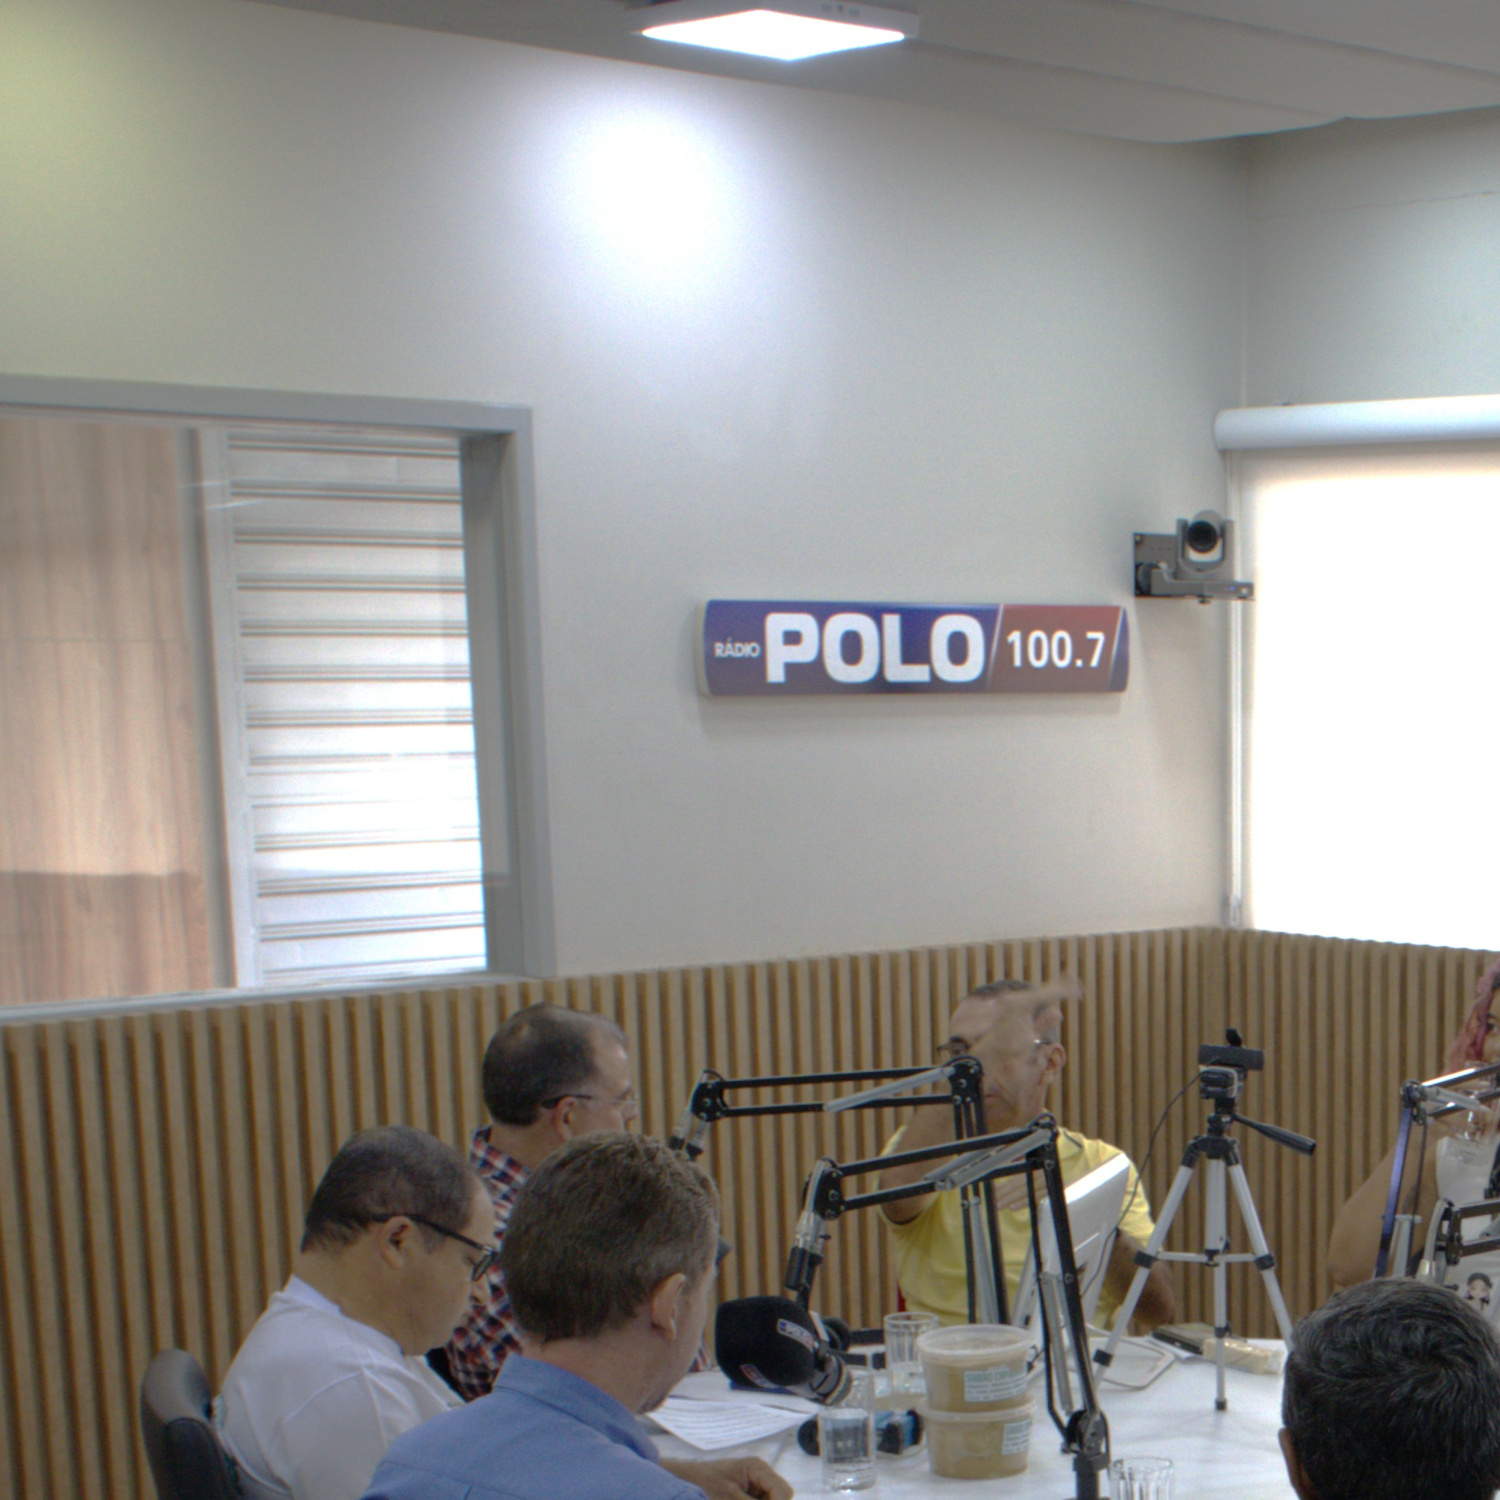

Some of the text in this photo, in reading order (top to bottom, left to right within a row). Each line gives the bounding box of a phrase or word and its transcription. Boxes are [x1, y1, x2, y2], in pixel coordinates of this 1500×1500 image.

[714, 612, 1105, 684] RÁDIO POLO 100.7
